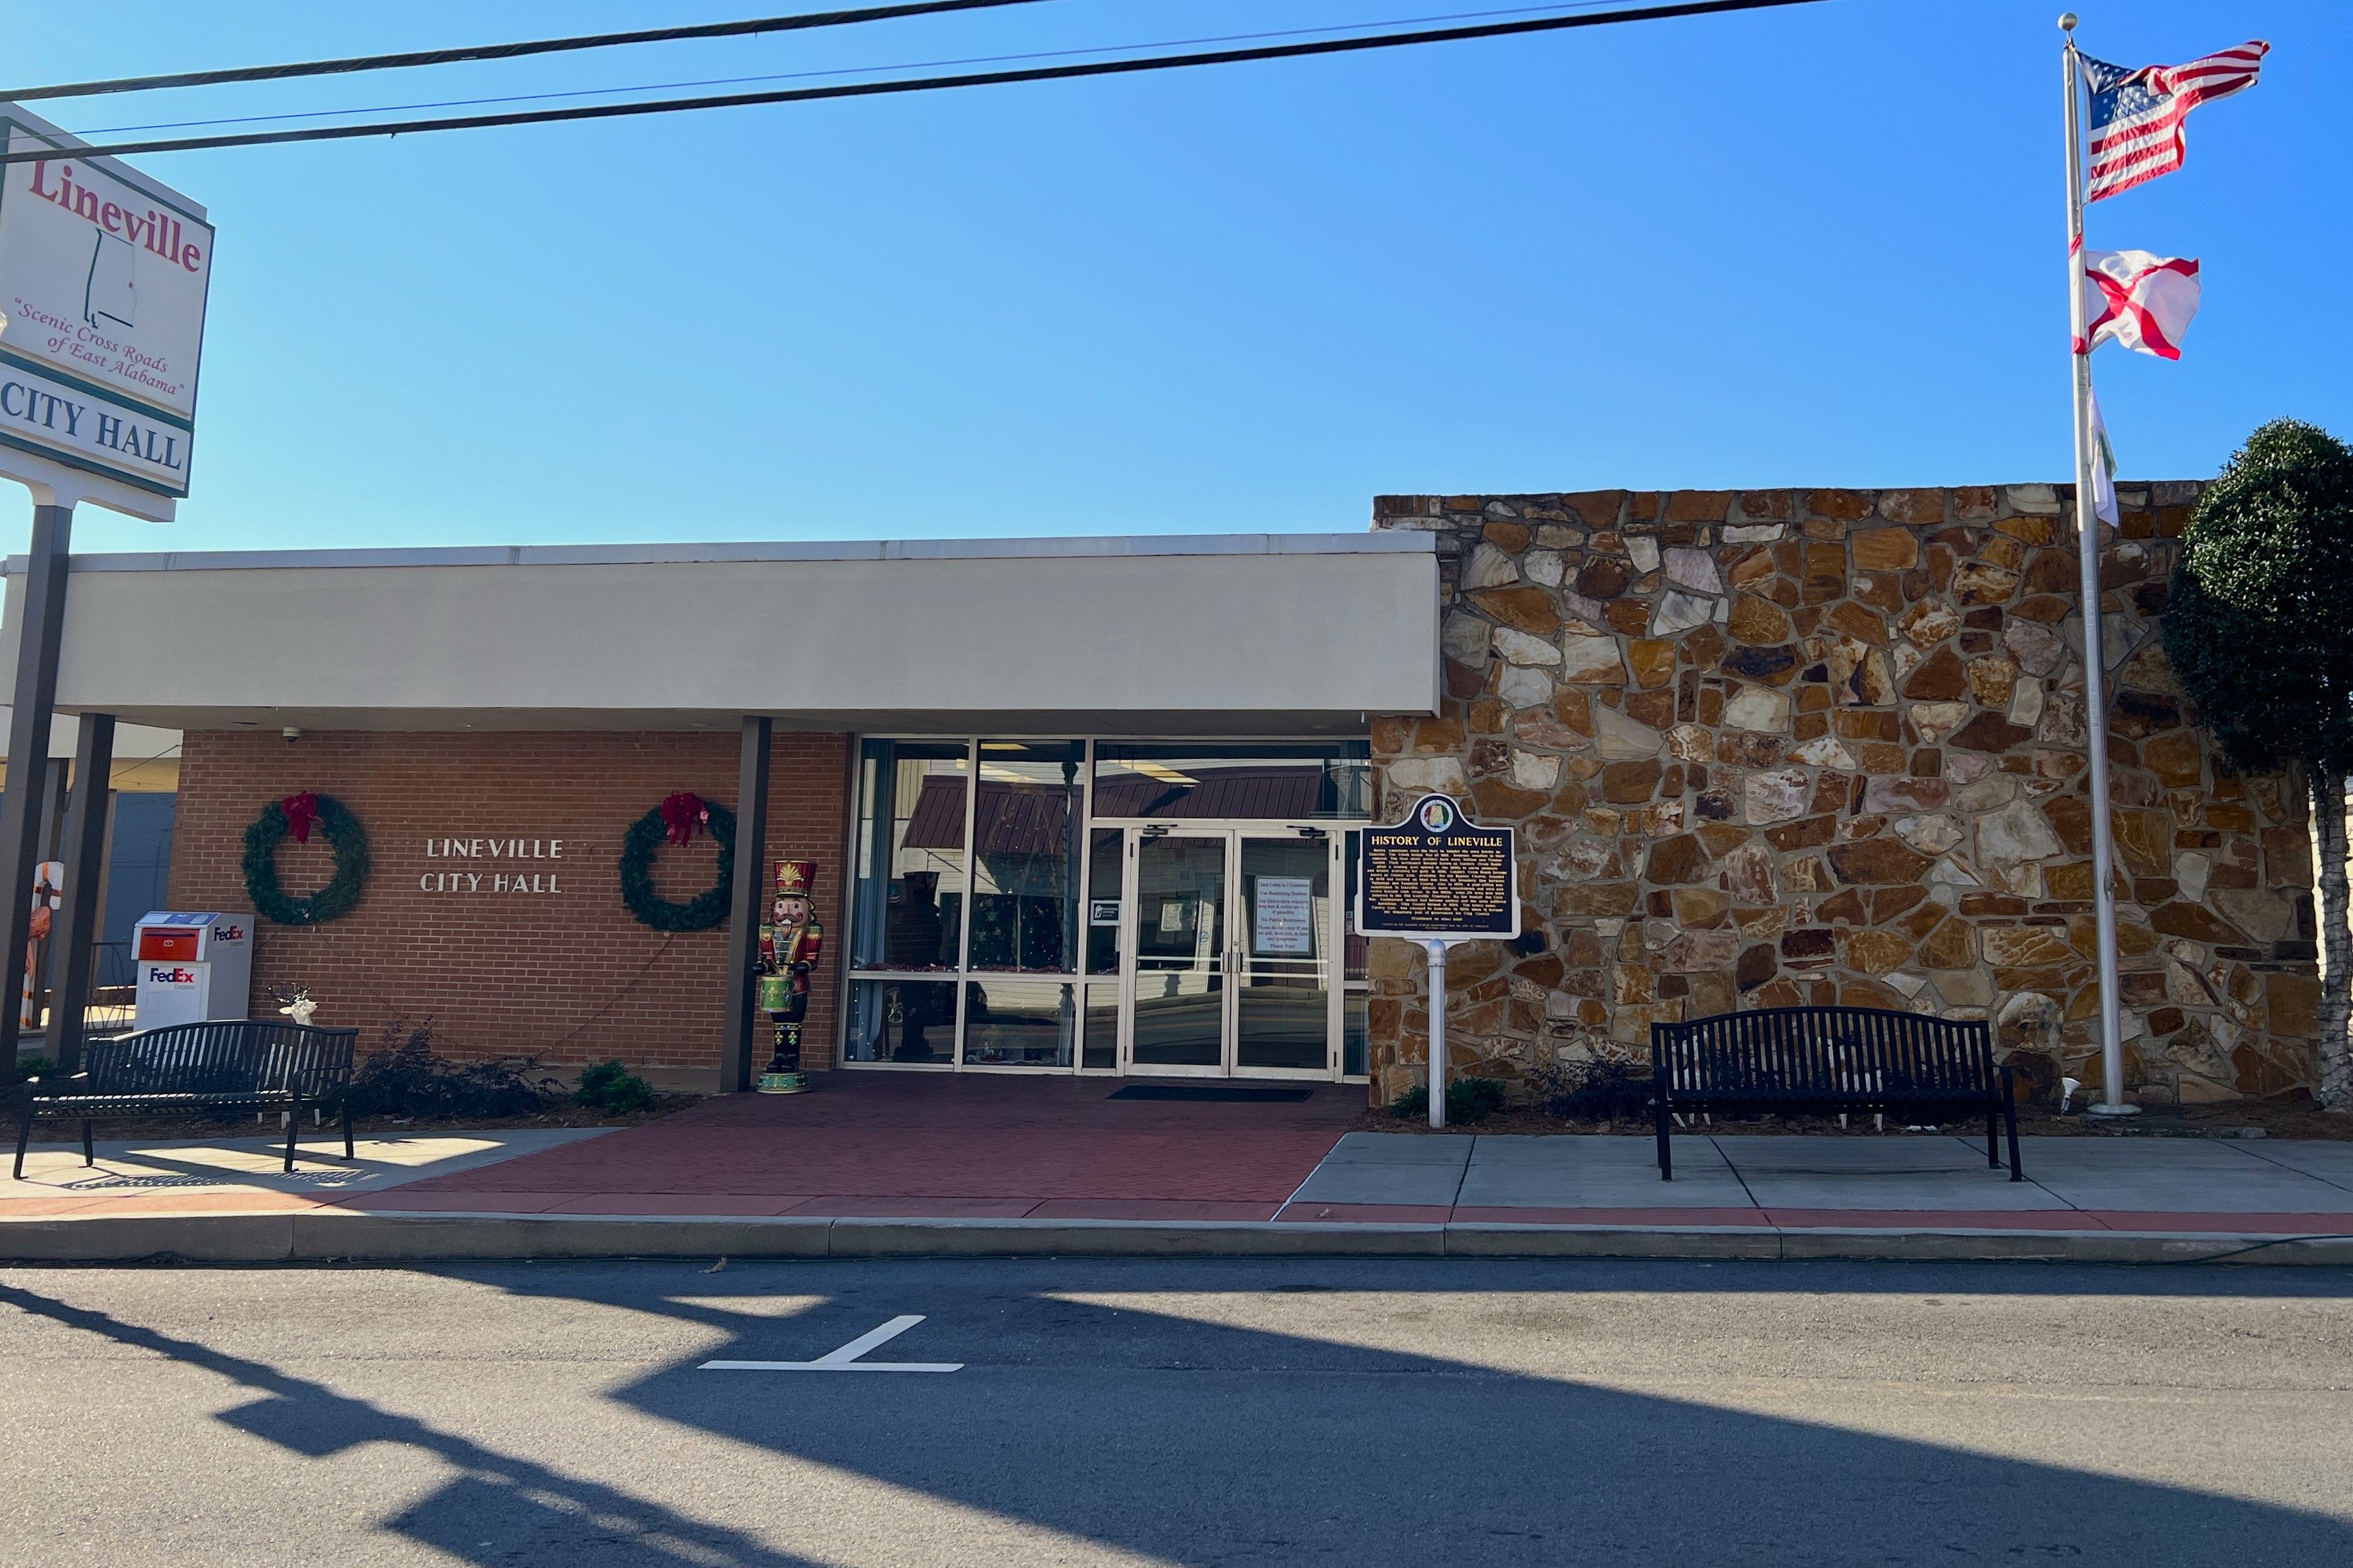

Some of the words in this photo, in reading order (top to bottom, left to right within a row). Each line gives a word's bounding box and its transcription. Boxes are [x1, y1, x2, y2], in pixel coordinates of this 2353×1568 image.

[29, 159, 200, 272] Lineville
[48, 337, 70, 353] of
[70, 343, 107, 367] East
[77, 327, 119, 352] Cross
[123, 345, 168, 373] Roads
[1, 382, 86, 437] CITY
[95, 412, 182, 470] HALL
[427, 839, 563, 858] LINEVILLE
[1372, 836, 1419, 846] HISTORY
[1427, 837, 1441, 846] OF
[1448, 837, 1503, 846] LINEVILLE
[420, 873, 483, 892] CITY
[494, 874, 561, 893] HALL
[214, 926, 244, 942] FedEx
[150, 968, 194, 983] FedEx
